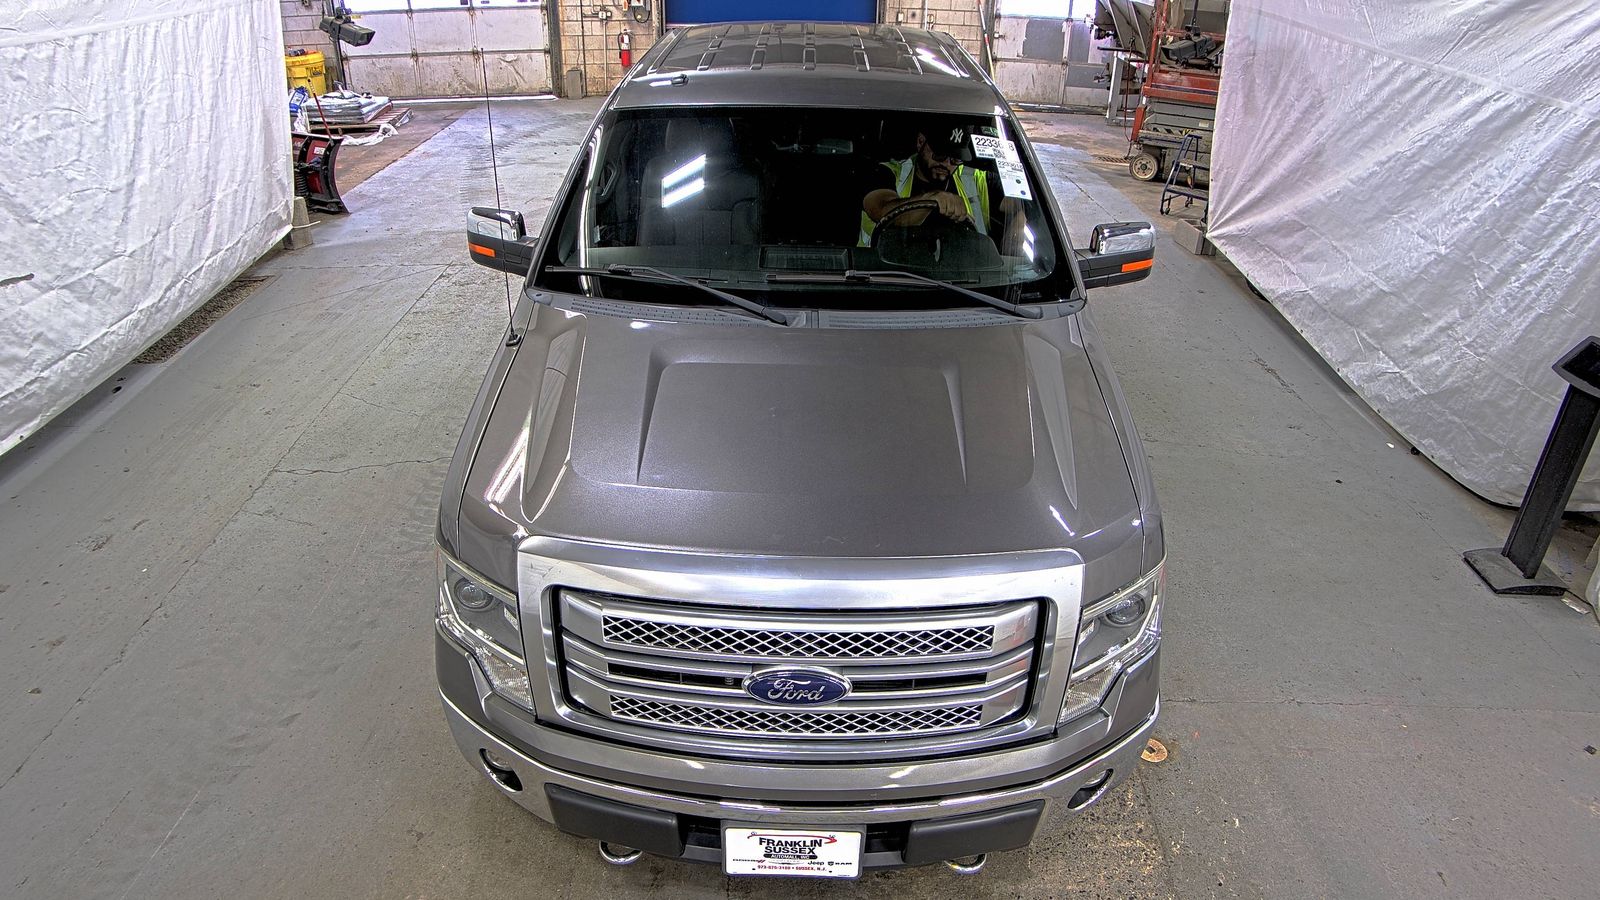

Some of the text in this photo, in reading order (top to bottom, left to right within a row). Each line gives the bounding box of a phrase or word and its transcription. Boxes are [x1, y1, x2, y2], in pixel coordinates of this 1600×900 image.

[950, 128, 964, 143] NY
[767, 678, 826, 701] Ford
[759, 837, 823, 848] FRANKLIN
[764, 846, 816, 855] SUSSEX
